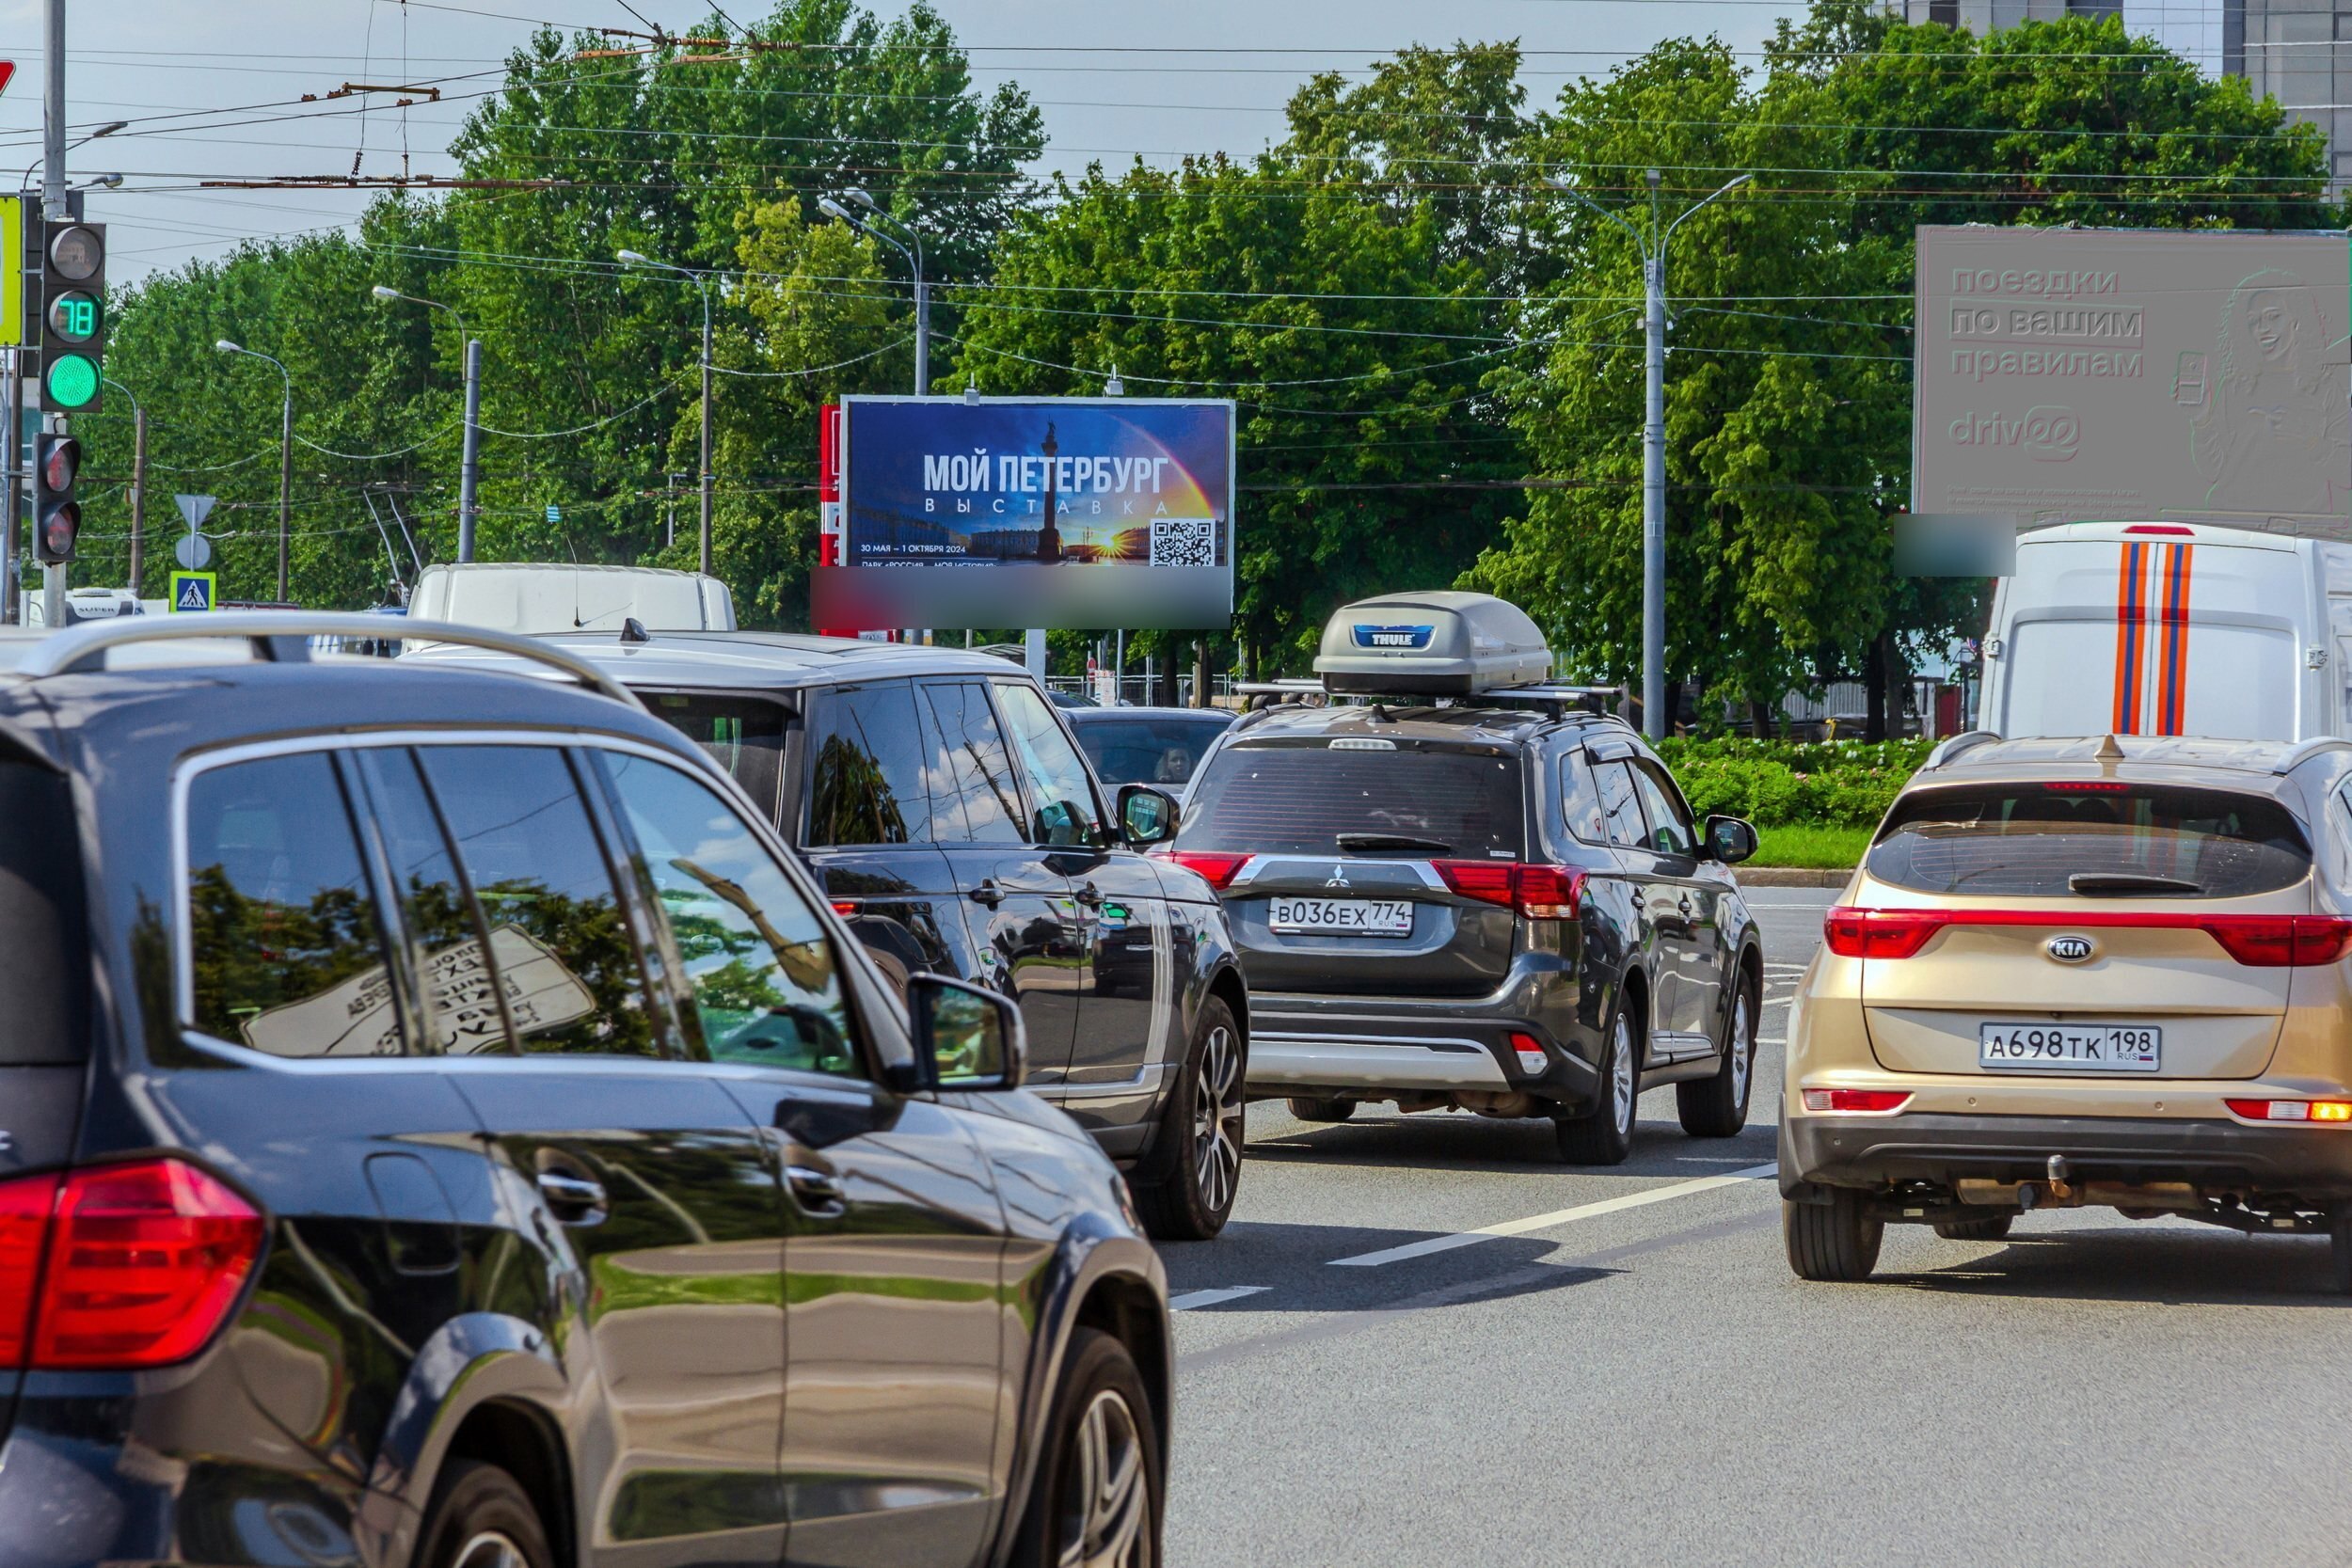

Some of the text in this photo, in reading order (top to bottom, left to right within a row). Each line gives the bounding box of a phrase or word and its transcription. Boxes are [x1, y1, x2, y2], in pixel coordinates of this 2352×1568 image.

[1952, 268, 2119, 300] поездки
[1952, 309, 2142, 337] по вашим
[1951, 350, 2143, 383] правилам
[924, 447, 1168, 493] МОЙ ПЕТЕРБУРГ
[925, 498, 1168, 515] ВЫСТАВКА
[861, 544, 871, 552] 30
[908, 545, 944, 553] ОКТЯБРЯ
[1372, 634, 1413, 646] THULE
[2055, 942, 2086, 956] KIA
[2118, 1053, 2138, 1061] RUS
